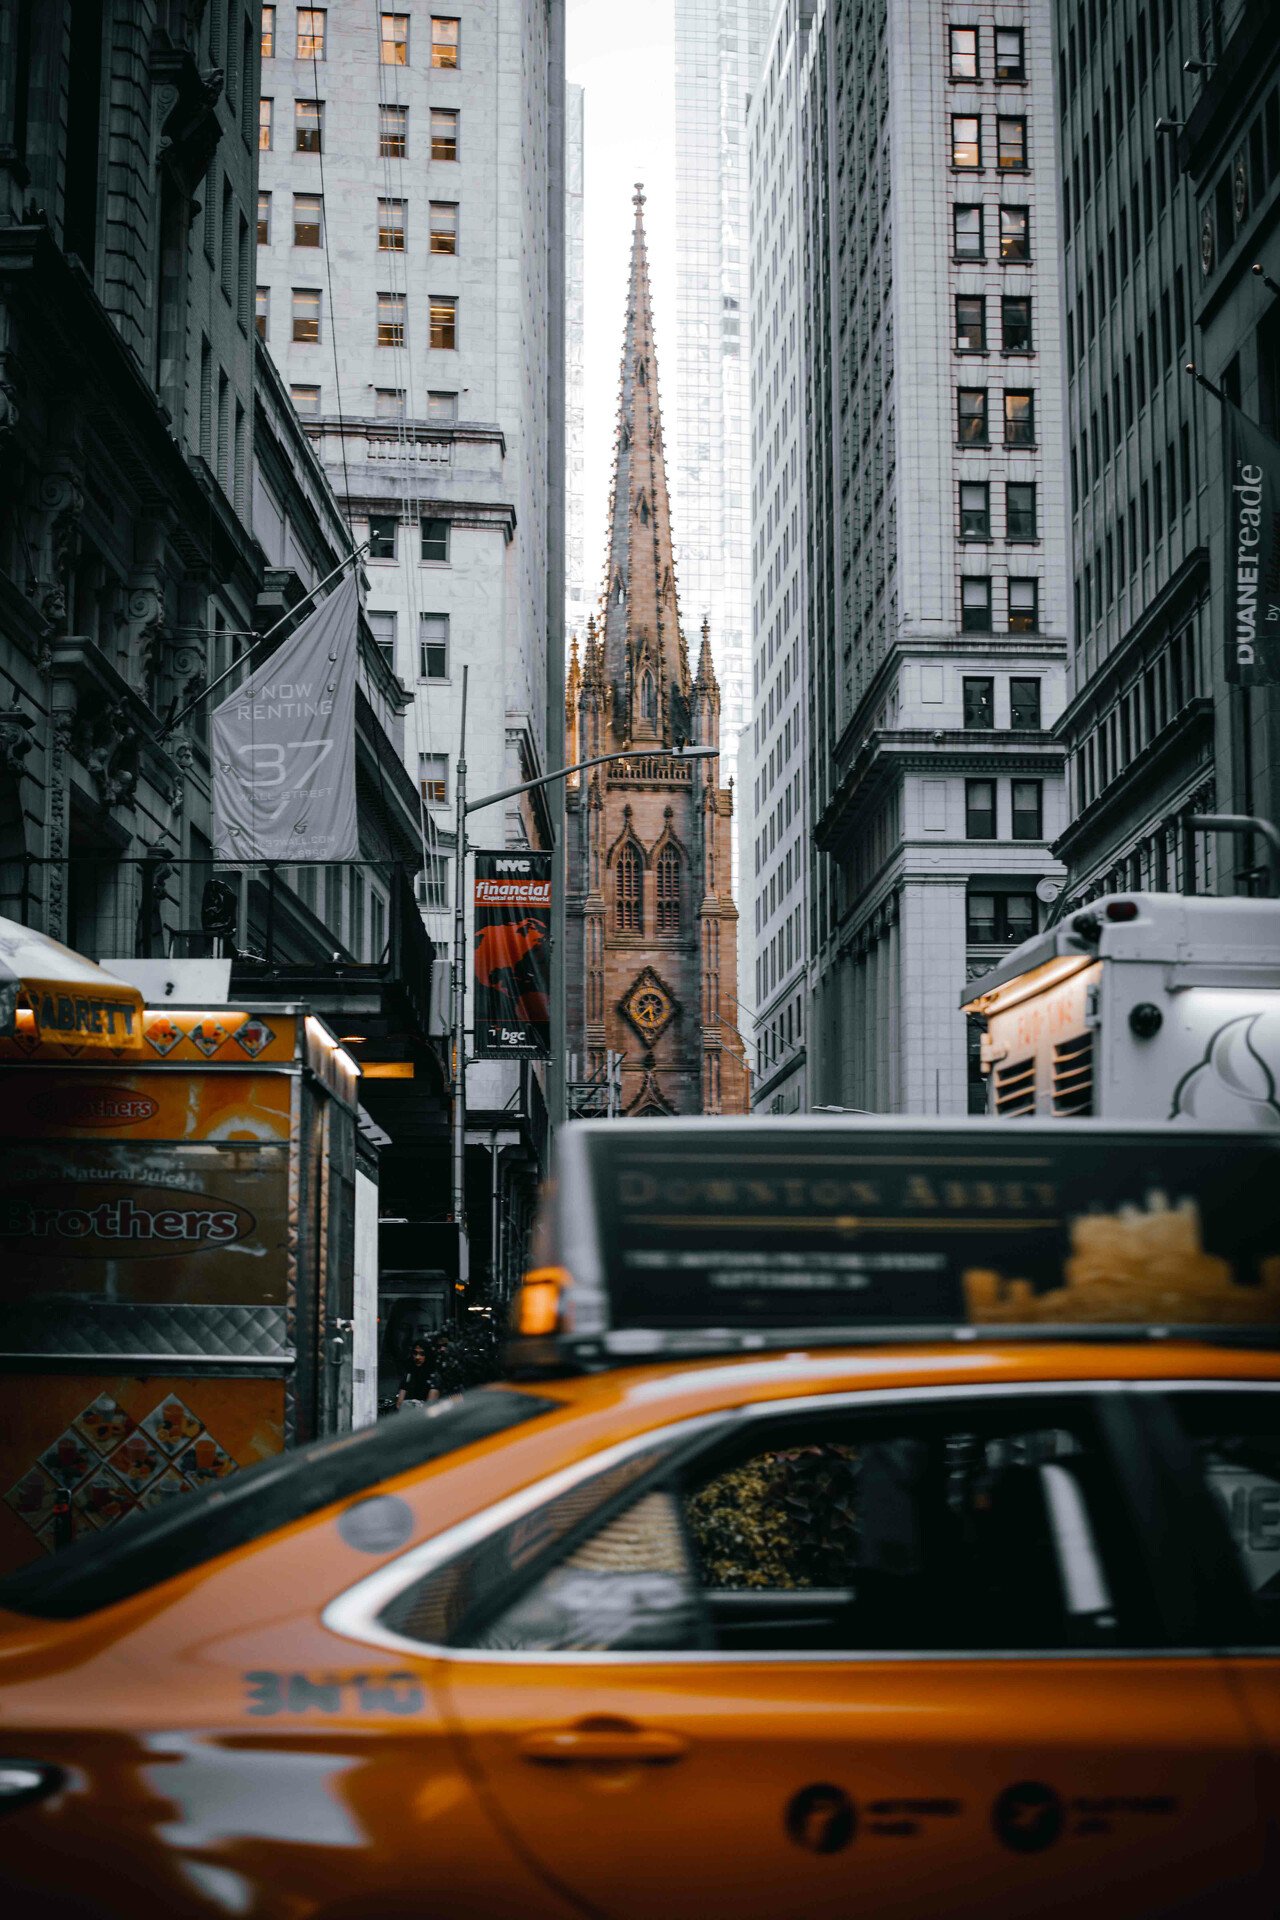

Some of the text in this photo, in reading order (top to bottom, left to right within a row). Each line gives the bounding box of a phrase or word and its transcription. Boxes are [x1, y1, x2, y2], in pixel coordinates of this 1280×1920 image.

[1265, 604, 1280, 621] by
[261, 683, 313, 700] NOW
[237, 700, 333, 720] RENTING
[238, 739, 334, 819] 37
[280, 787, 334, 800] STREET
[495, 860, 531, 872] NYC
[476, 882, 550, 898] financial
[501, 1028, 526, 1044] bgc
[62, 1099, 152, 1118] others
[63, 1166, 134, 1181] Natural
[0, 1200, 240, 1240] Brothers
